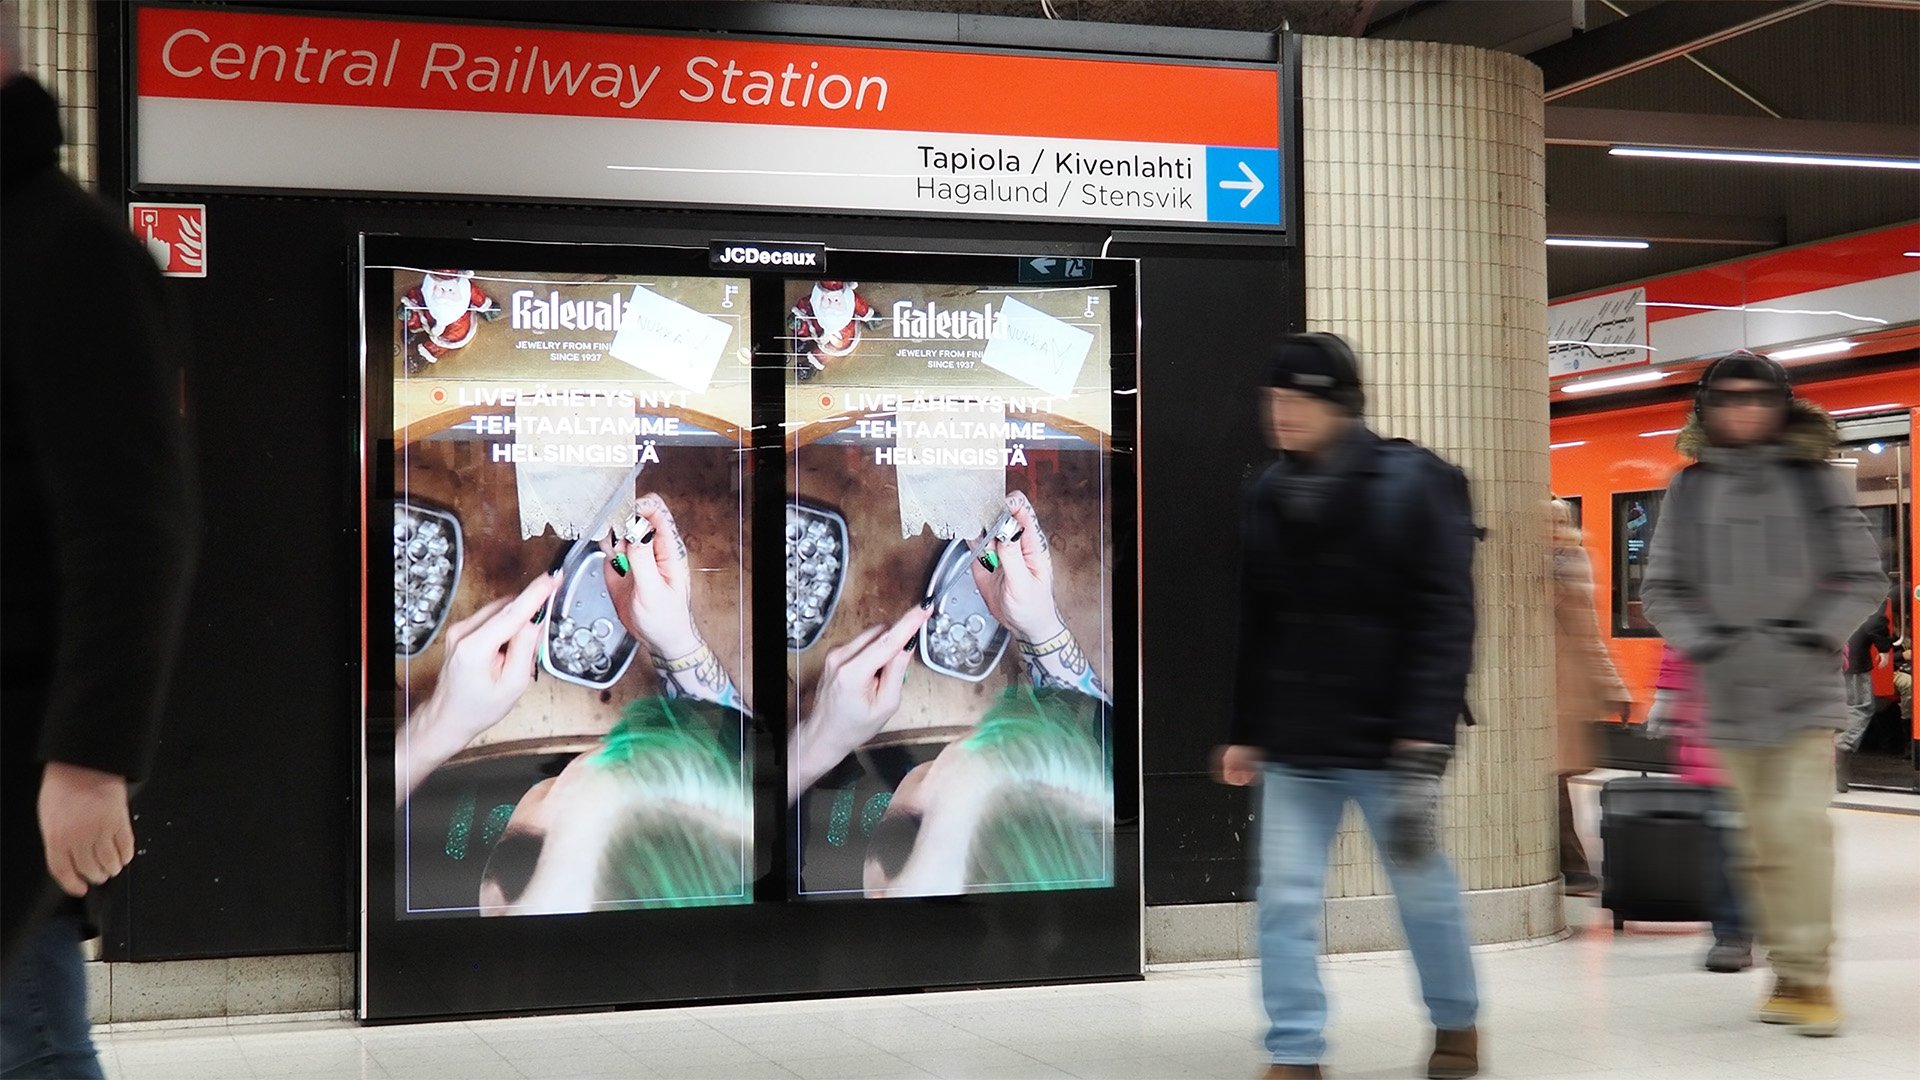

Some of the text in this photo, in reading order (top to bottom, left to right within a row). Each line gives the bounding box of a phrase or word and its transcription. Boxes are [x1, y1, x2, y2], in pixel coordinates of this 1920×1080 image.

[162, 28, 888, 112] Central Railway Station
[917, 146, 1020, 174] Tapiola
[1056, 152, 1192, 180] Kivenlahti
[917, 177, 1048, 205] Hagalund
[1083, 184, 1192, 210] Stensvik
[720, 247, 816, 265] JCDecaux
[515, 340, 561, 350] JEWELRY
[562, 341, 592, 350] FROM
[896, 348, 938, 358] JEWELRY
[939, 350, 966, 358] FROM
[550, 352, 603, 362] SINCE 1937
[927, 360, 976, 369] SINCE 1937
[458, 383, 692, 409] LIVELÄHETYS NYT
[843, 390, 1054, 414] LIVELÄHETYS NYT
[470, 415, 680, 437] TEHTAALTAMME
[855, 420, 1046, 441] TEHTAALTAMME
[492, 440, 660, 464] HELSINGISTÄ
[875, 443, 1028, 467] HELSINGISTÄ
